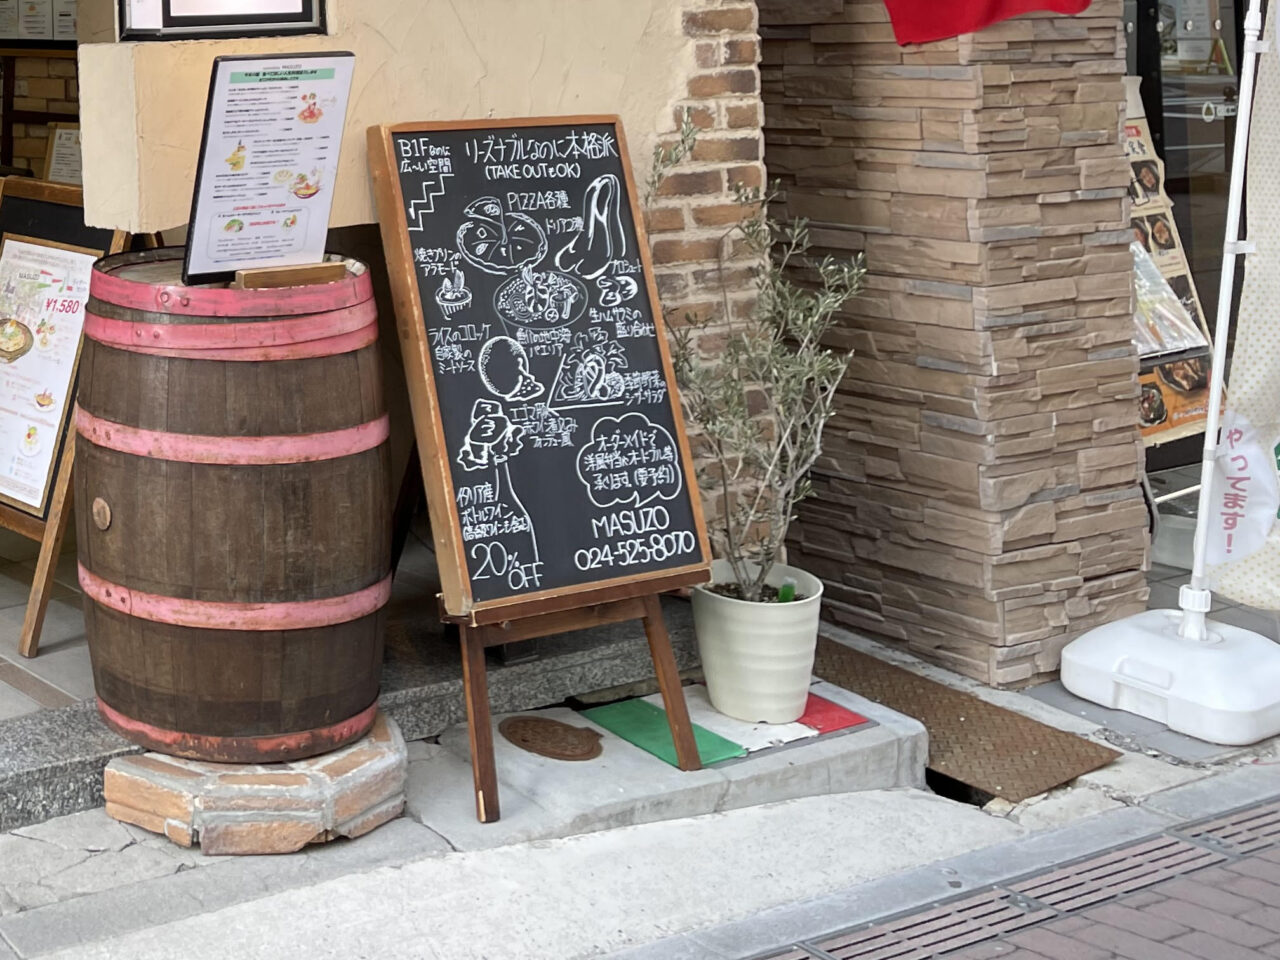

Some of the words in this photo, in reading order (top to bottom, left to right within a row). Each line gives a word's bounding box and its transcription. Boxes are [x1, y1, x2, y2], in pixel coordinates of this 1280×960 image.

[465, 130, 619, 163] リーズナブルなのに本格派
[485, 163, 521, 180] (TAKE
[507, 190, 571, 211] PIZZA各種
[420, 261, 460, 277] アラモード
[439, 359, 476, 375] ミートソース
[591, 506, 670, 539] MASUZO
[471, 541, 519, 581] 20%
[574, 531, 696, 571] 024-525-8070
[508, 561, 545, 590] OFF
